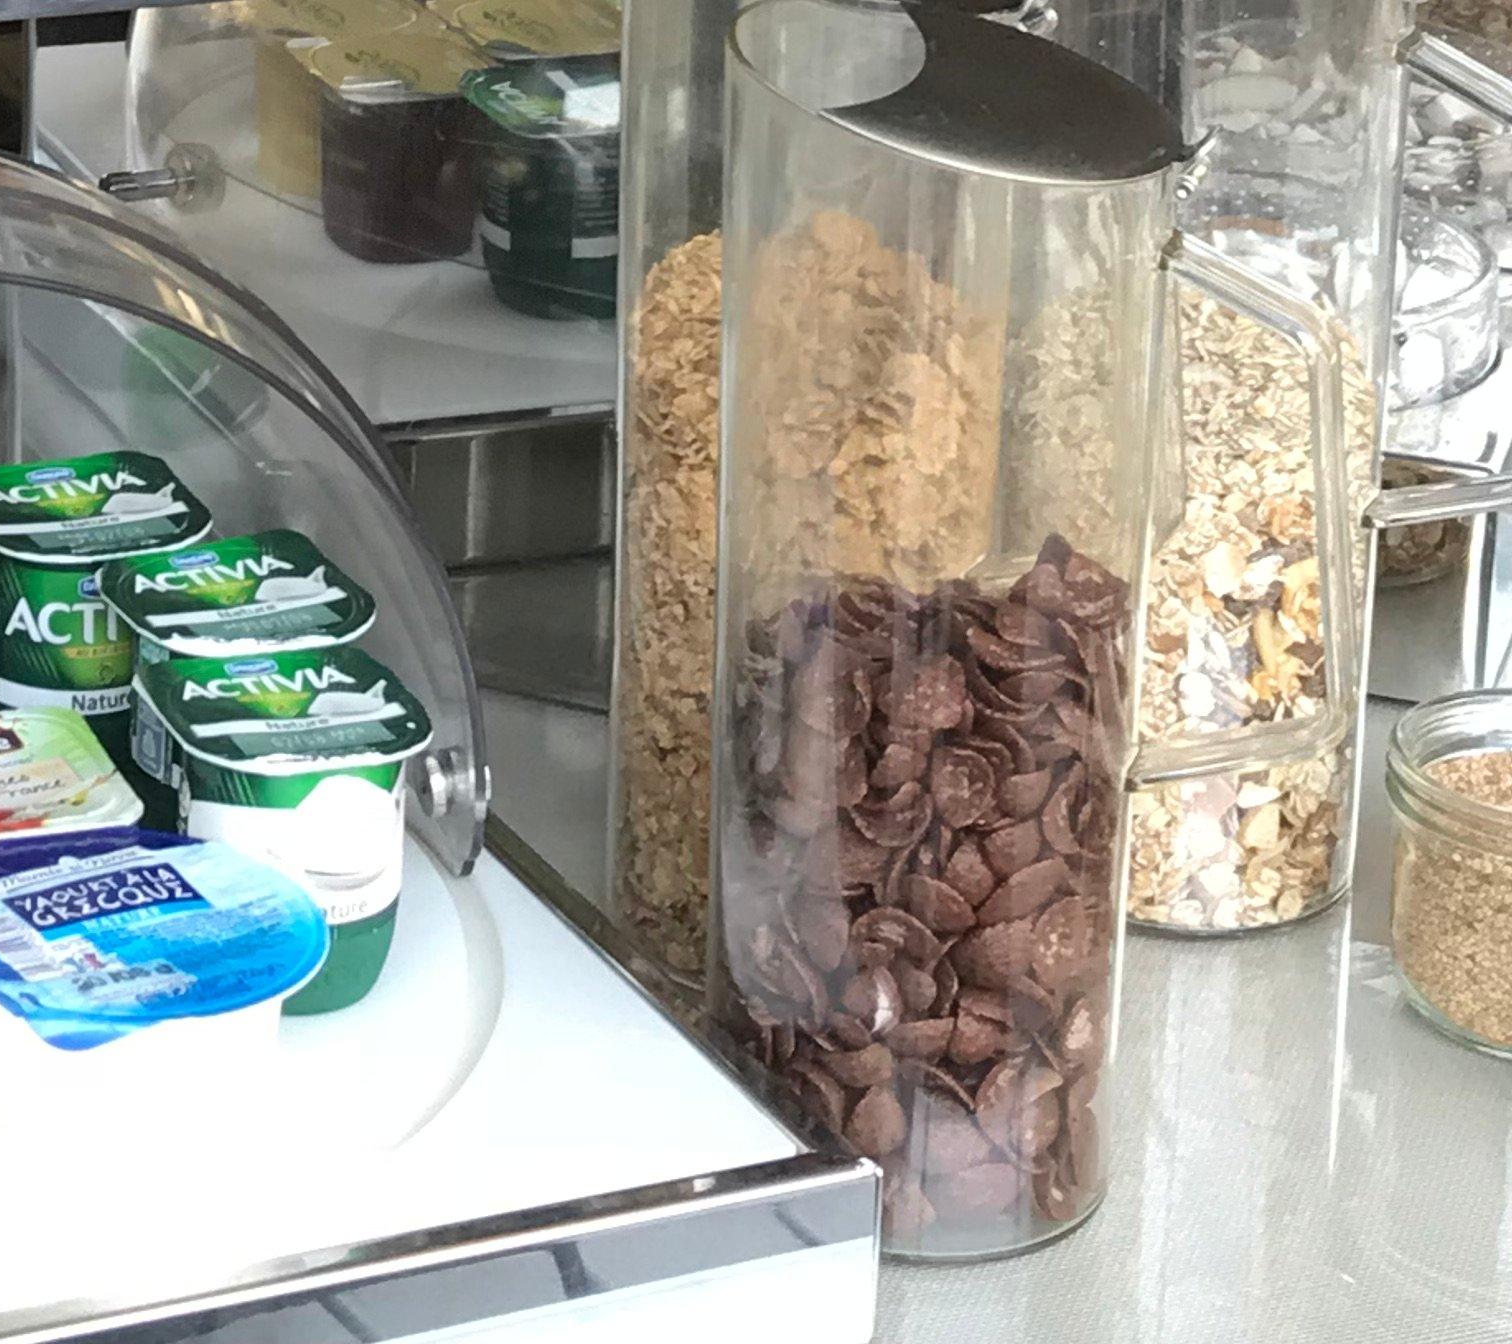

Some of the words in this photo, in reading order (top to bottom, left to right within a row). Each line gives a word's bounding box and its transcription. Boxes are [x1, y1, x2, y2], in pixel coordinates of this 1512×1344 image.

[134, 554, 295, 594] ACTIVIA
[4, 597, 118, 645] ACTI
[72, 693, 128, 712] Natur
[182, 665, 356, 701] ACTIVIA
[14, 875, 120, 912] YAOURT
[144, 867, 177, 885] LA
[32, 879, 193, 928] GRECQUE
[324, 901, 368, 920] ture
